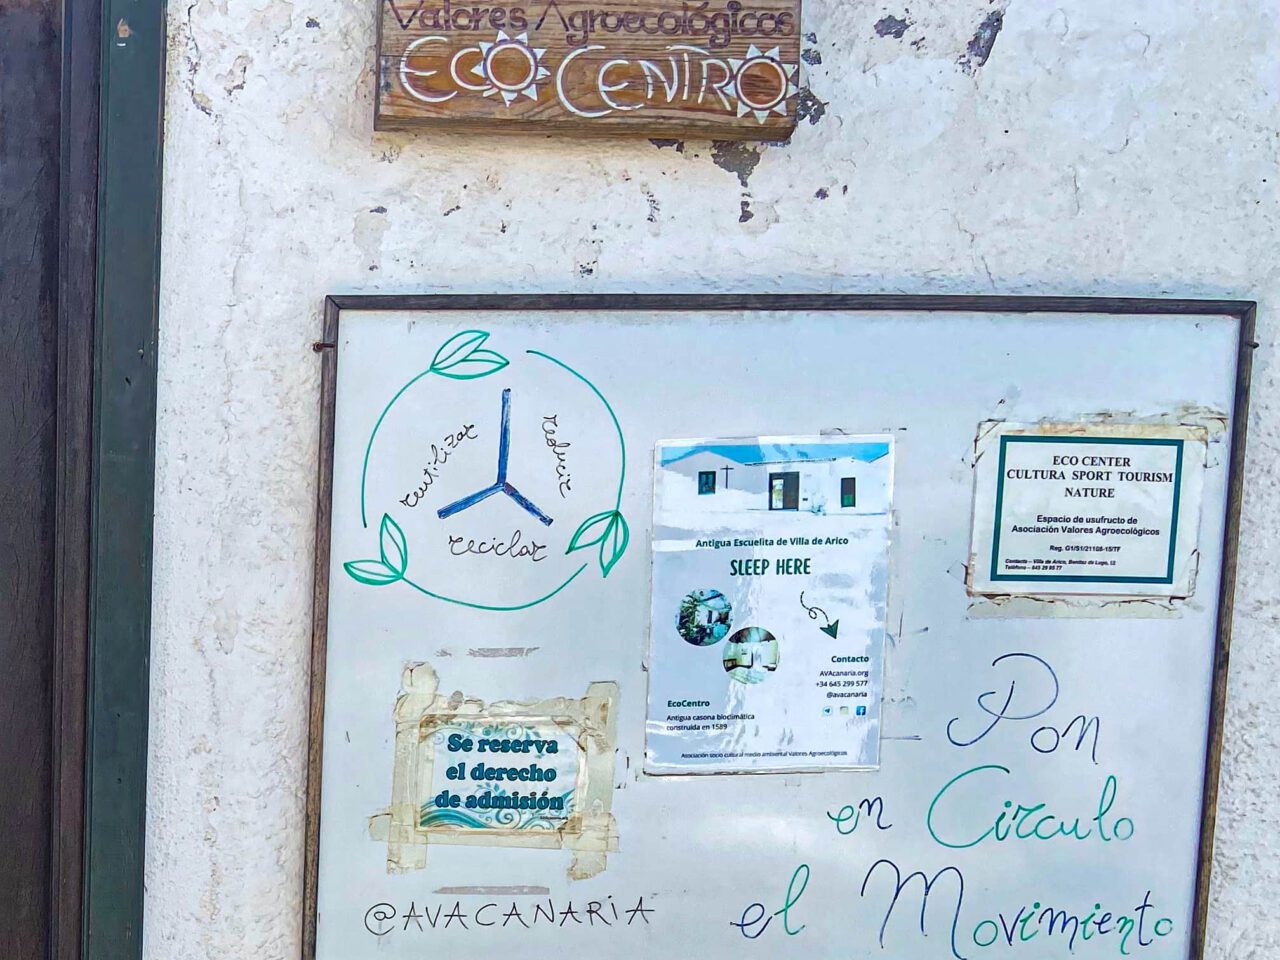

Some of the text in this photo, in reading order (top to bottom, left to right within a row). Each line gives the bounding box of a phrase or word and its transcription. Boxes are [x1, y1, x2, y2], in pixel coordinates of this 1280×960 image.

[388, 0, 530, 31] Valores
[542, 414, 571, 499] reducir
[1053, 455, 1131, 467] ECO CENTER
[400, 424, 478, 508] reutilizar
[1006, 469, 1174, 483] CULTURA SPORT TOURISM
[1064, 488, 1115, 498] NATURE
[1036, 515, 1138, 524] Espacio de usufructo de
[1011, 525, 1160, 537] Asociación Valores Agroecológicos
[448, 530, 548, 562] reciclar
[695, 536, 849, 549] Antigua Escuelita de Villa de Arico
[730, 558, 811, 576] SLEEP HERE
[831, 655, 870, 663] Contacto
[667, 700, 710, 708] EcoCentro
[947, 652, 1100, 764] Pon
[666, 714, 692, 722] Antigua
[447, 734, 559, 754] Se reserva
[446, 763, 557, 782] el derecho
[434, 790, 564, 810] de admisión
[827, 796, 892, 835] en
[730, 859, 1174, 960] el Movimiento
